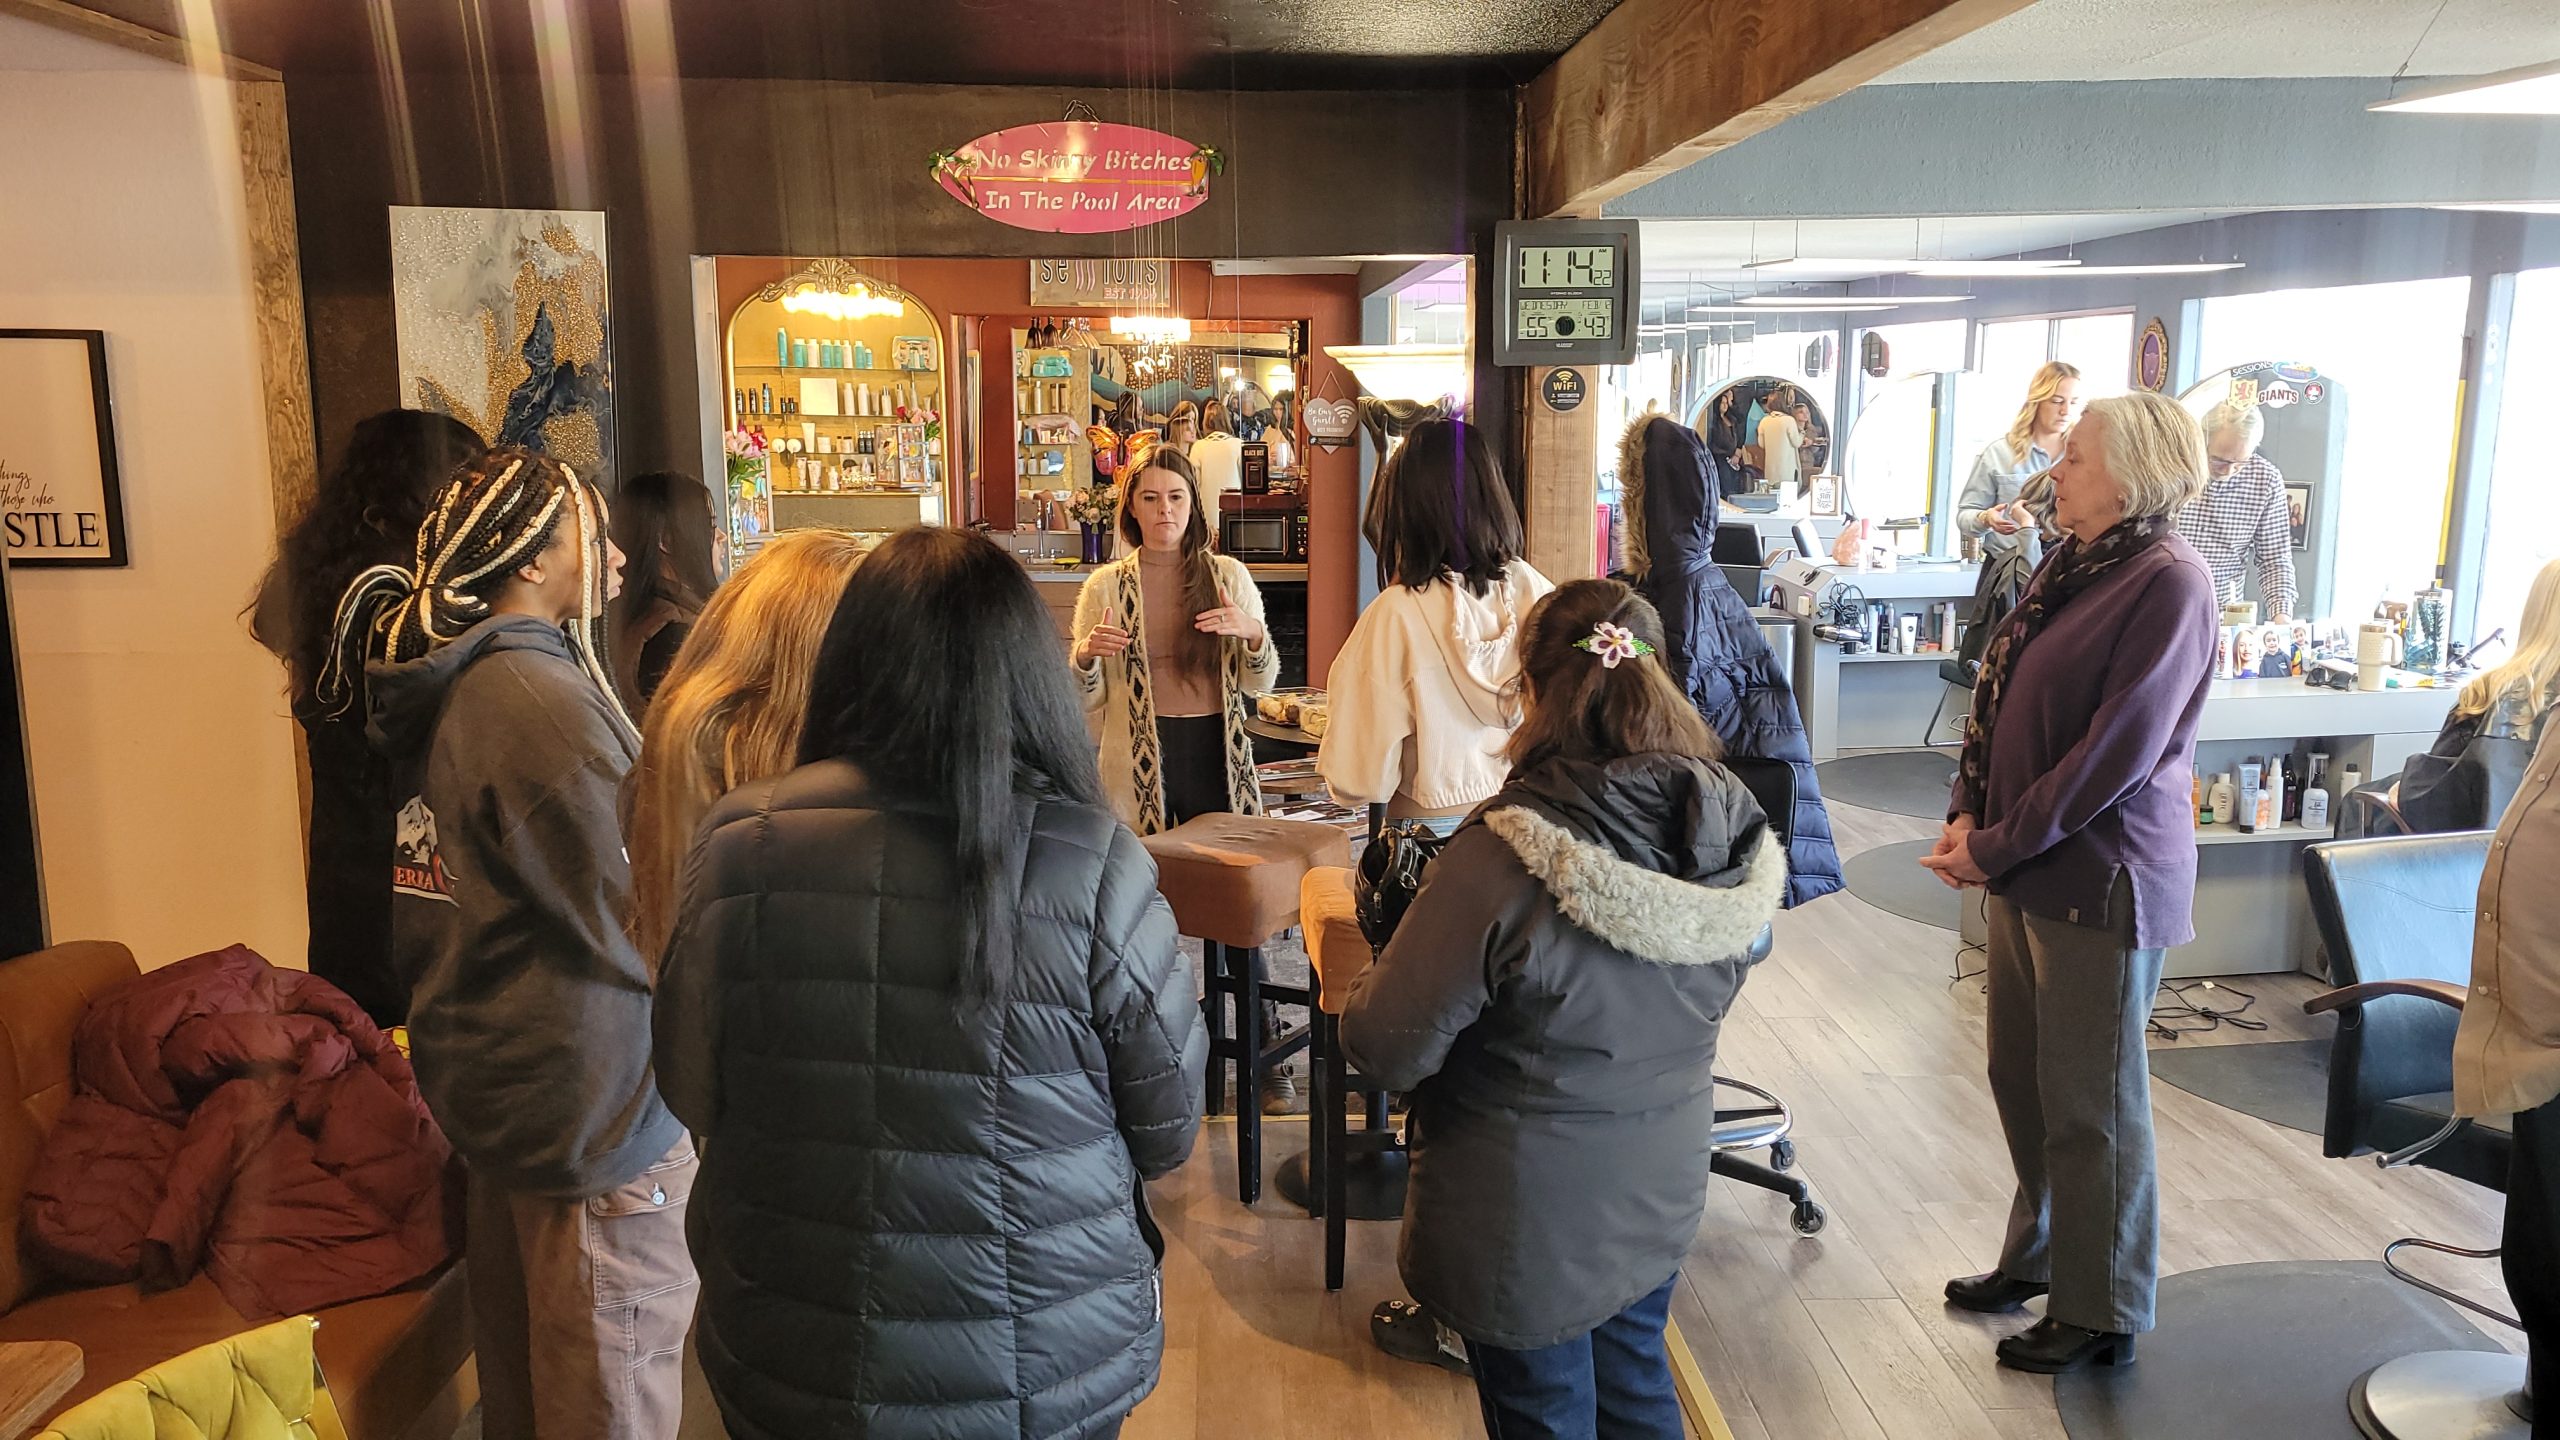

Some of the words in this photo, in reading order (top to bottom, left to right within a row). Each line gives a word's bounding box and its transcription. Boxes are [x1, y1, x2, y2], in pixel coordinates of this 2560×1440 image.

[976, 149, 1011, 169] No
[1018, 149, 1098, 176] Skinny
[1105, 149, 1192, 170] Bitches
[985, 190, 1010, 209] In
[1019, 191, 1064, 210] The
[1071, 191, 1119, 211] Pool
[1126, 192, 1181, 211] Area
[1521, 250, 1594, 285] 11:14
[1593, 270, 1611, 286] 22
[1520, 300, 1568, 311] WEDNESDAY
[1584, 316, 1605, 337] 43
[2259, 389, 2298, 403] GIANTS
[0, 459, 32, 493] hings
[31, 483, 55, 507] who
[4, 511, 101, 548] STLE
[394, 866, 436, 891] ERIA
